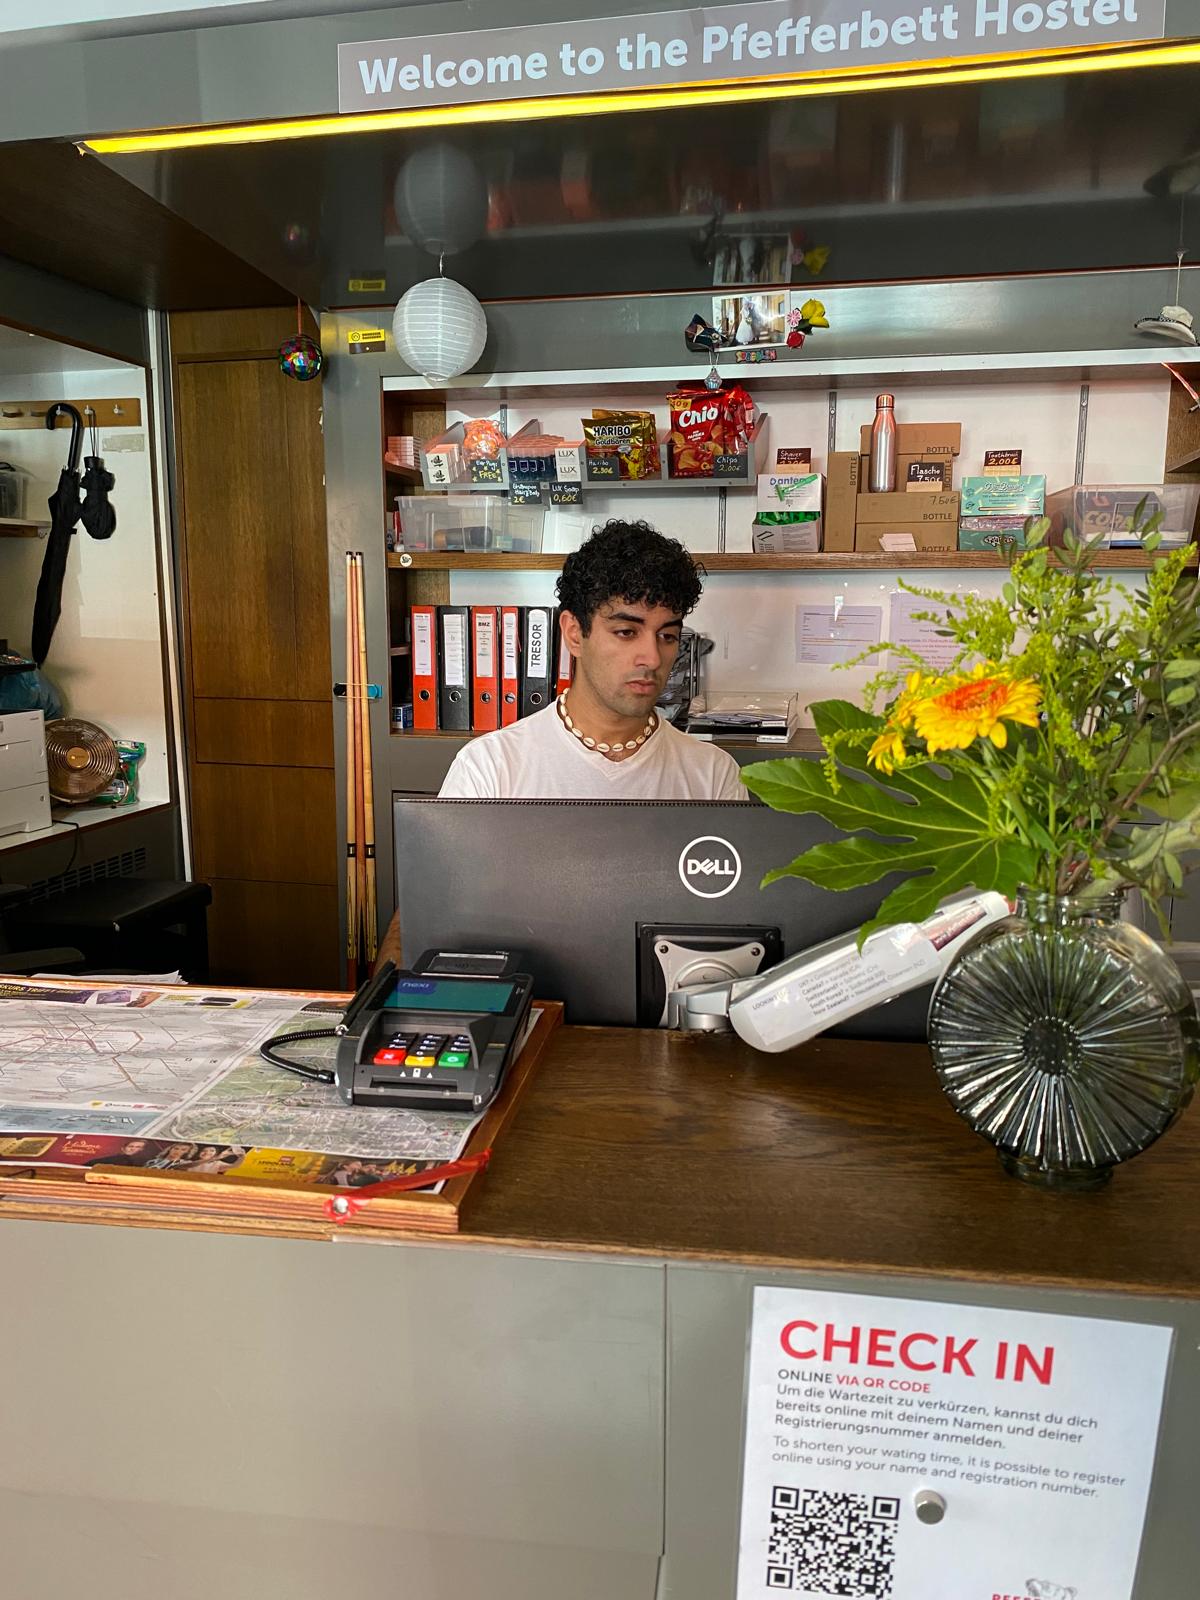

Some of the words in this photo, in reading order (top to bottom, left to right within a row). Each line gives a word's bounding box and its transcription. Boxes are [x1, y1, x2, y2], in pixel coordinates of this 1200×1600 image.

[358, 51, 548, 94] Welcome
[560, 43, 605, 76] to
[616, 32, 688, 71] the
[702, 4, 959, 64] Pfefferbett
[975, 0, 1139, 36] Hostel
[593, 425, 631, 437] HARIBO
[678, 405, 719, 428] Chio
[716, 456, 738, 466] Chips
[850, 456, 858, 486] BOTTLE
[910, 464, 941, 476] Flasche
[988, 458, 1018, 466] 2,00€
[554, 494, 577, 502] 0,60€
[531, 624, 542, 668] TRESOR
[687, 858, 735, 876] DELL
[779, 1319, 979, 1377] CHECK
[994, 1341, 1055, 1386] IN
[778, 1368, 832, 1384] ONLINE
[836, 1374, 860, 1386] VIA
[863, 1376, 885, 1389] QR
[888, 1380, 932, 1394] CODE
[776, 1384, 800, 1396] Um
[804, 1387, 824, 1398] die
[828, 1388, 894, 1405] Wartezeit
[897, 1396, 914, 1407] zu
[918, 1399, 990, 1417] verkürzen,
[994, 1406, 1041, 1422] kannst
[1044, 1413, 1063, 1425] du
[1067, 1416, 1098, 1430] dich
[776, 1399, 822, 1414] bereits
[824, 1404, 867, 1418] online
[871, 1409, 893, 1420] mit
[897, 1412, 948, 1427] deinem
[952, 1417, 1003, 1434] Namen
[1007, 1424, 1034, 1438] und
[1038, 1428, 1084, 1444] deiner
[775, 1414, 930, 1440] Registrierungsnummer
[932, 1432, 1006, 1450] anmelden.
[772, 1435, 790, 1448] To
[793, 1438, 844, 1454] shorten
[847, 1444, 878, 1456] your
[882, 1448, 926, 1463] wating
[930, 1452, 964, 1466] time,
[968, 1456, 976, 1466] it
[980, 1458, 990, 1468] is
[994, 1460, 1052, 1477] possible
[1054, 1468, 1070, 1479] to
[1072, 1471, 1126, 1487] register
[772, 1452, 813, 1464] online
[816, 1456, 852, 1470] using
[855, 1460, 886, 1473] your
[889, 1463, 928, 1476] name
[931, 1465, 956, 1478] and
[960, 1470, 1038, 1489] registration
[1040, 1482, 1099, 1498] number.
